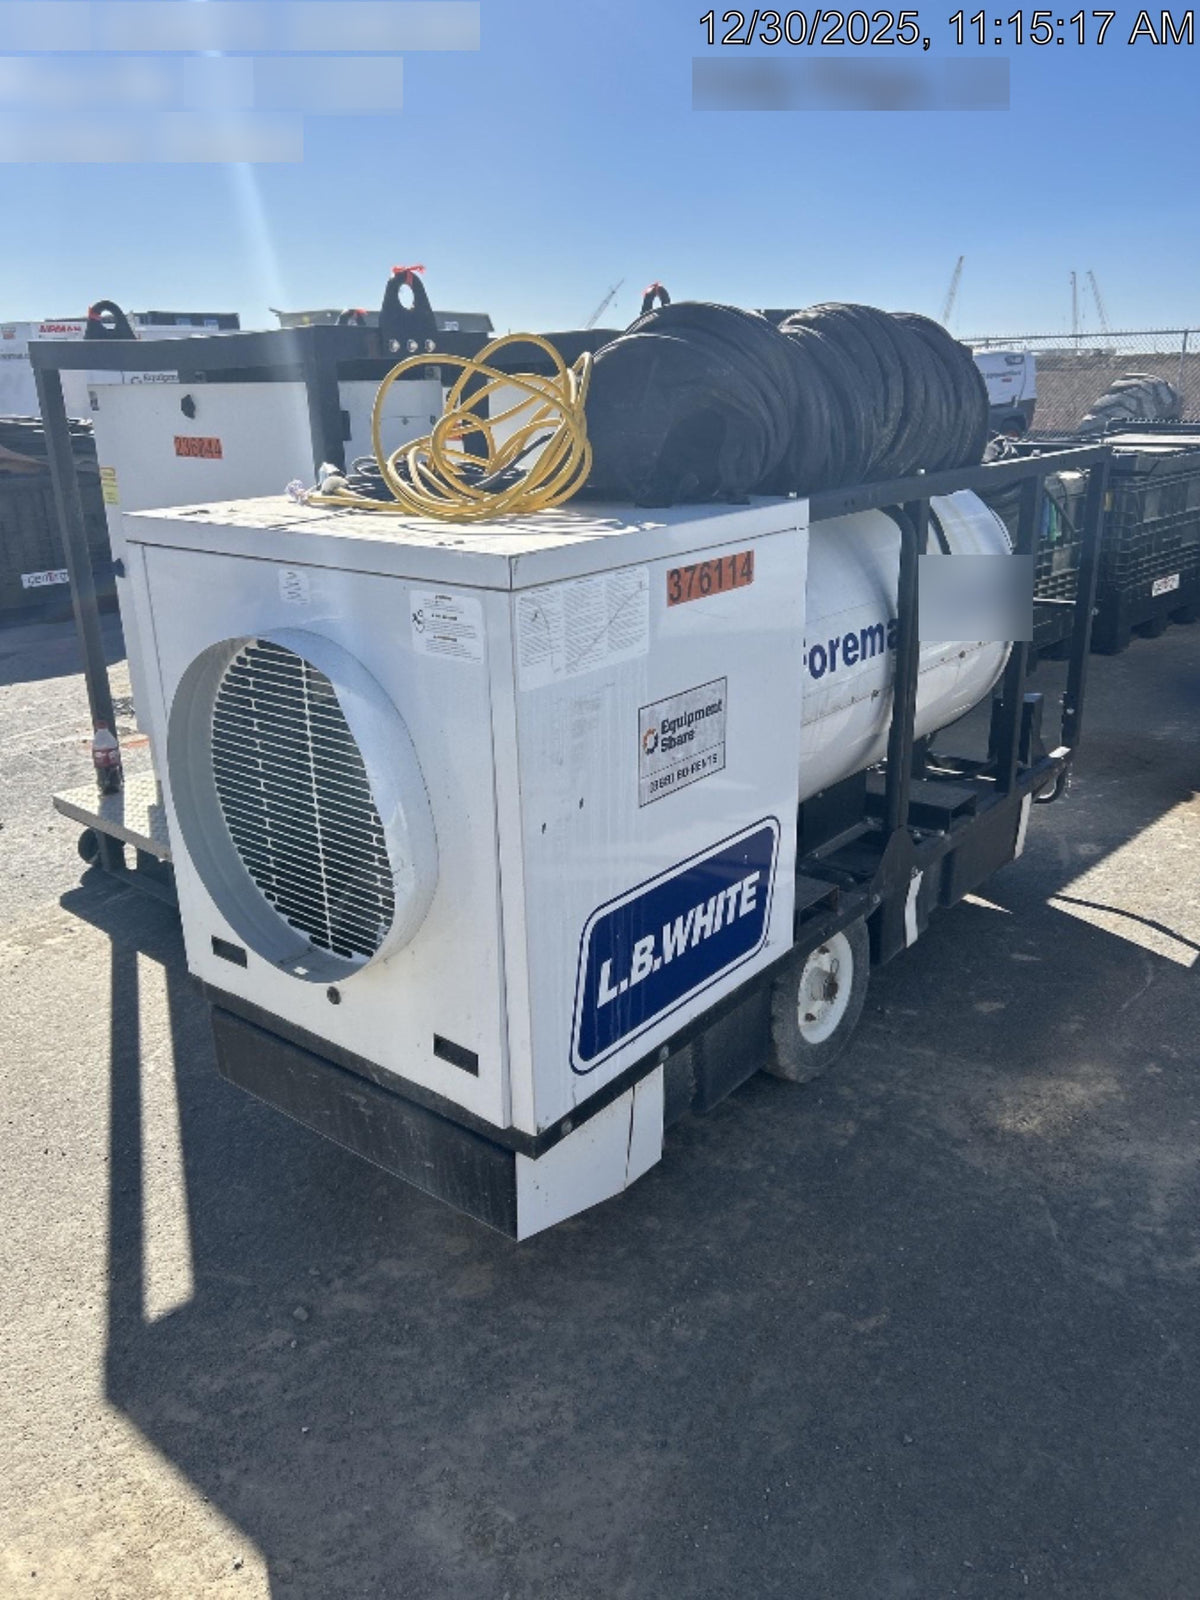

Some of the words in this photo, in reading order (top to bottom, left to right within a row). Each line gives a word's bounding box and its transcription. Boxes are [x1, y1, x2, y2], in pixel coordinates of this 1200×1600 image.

[669, 550, 753, 605] 376114
[660, 698, 723, 735] Equipment
[660, 729, 696, 753] Share
